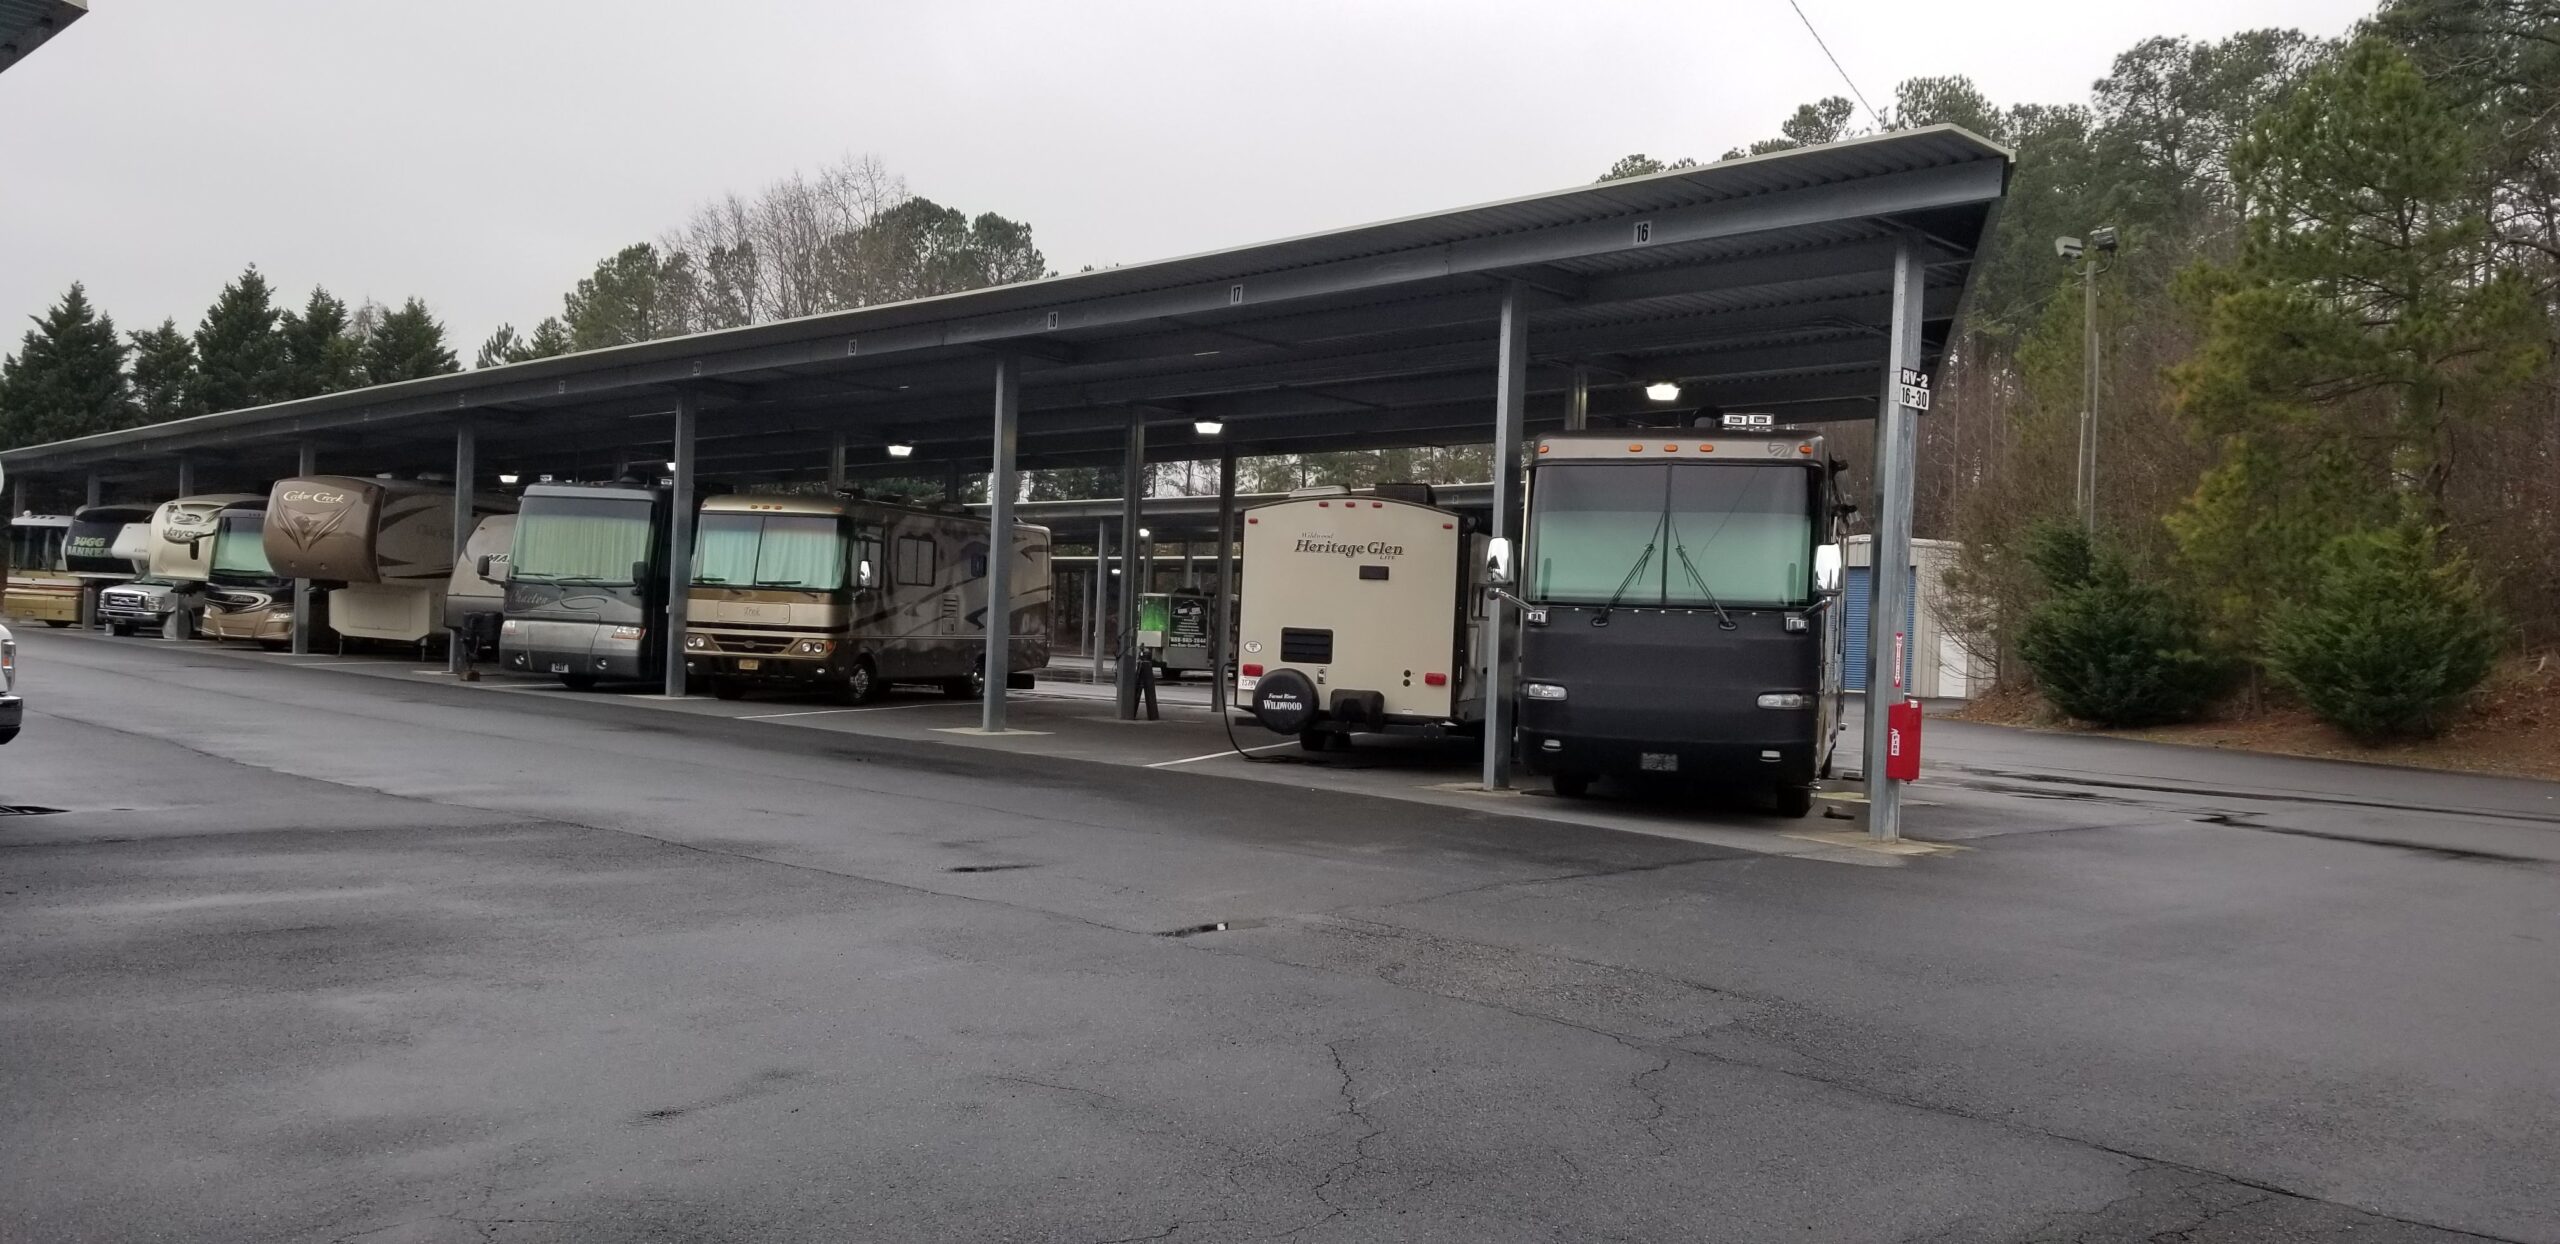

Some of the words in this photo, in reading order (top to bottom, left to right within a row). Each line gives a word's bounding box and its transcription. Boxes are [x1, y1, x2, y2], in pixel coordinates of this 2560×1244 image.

[1636, 223, 1649, 243] 16
[1232, 286, 1241, 303] 17
[1049, 313, 1057, 328] 18
[1902, 369, 1929, 388] RV-2
[1901, 387, 1927, 408] 16-30
[313, 492, 344, 504] Creek
[1294, 539, 1365, 558] Heritage
[1367, 541, 1404, 556] Glen
[1263, 699, 1303, 711] WILDWOOD
